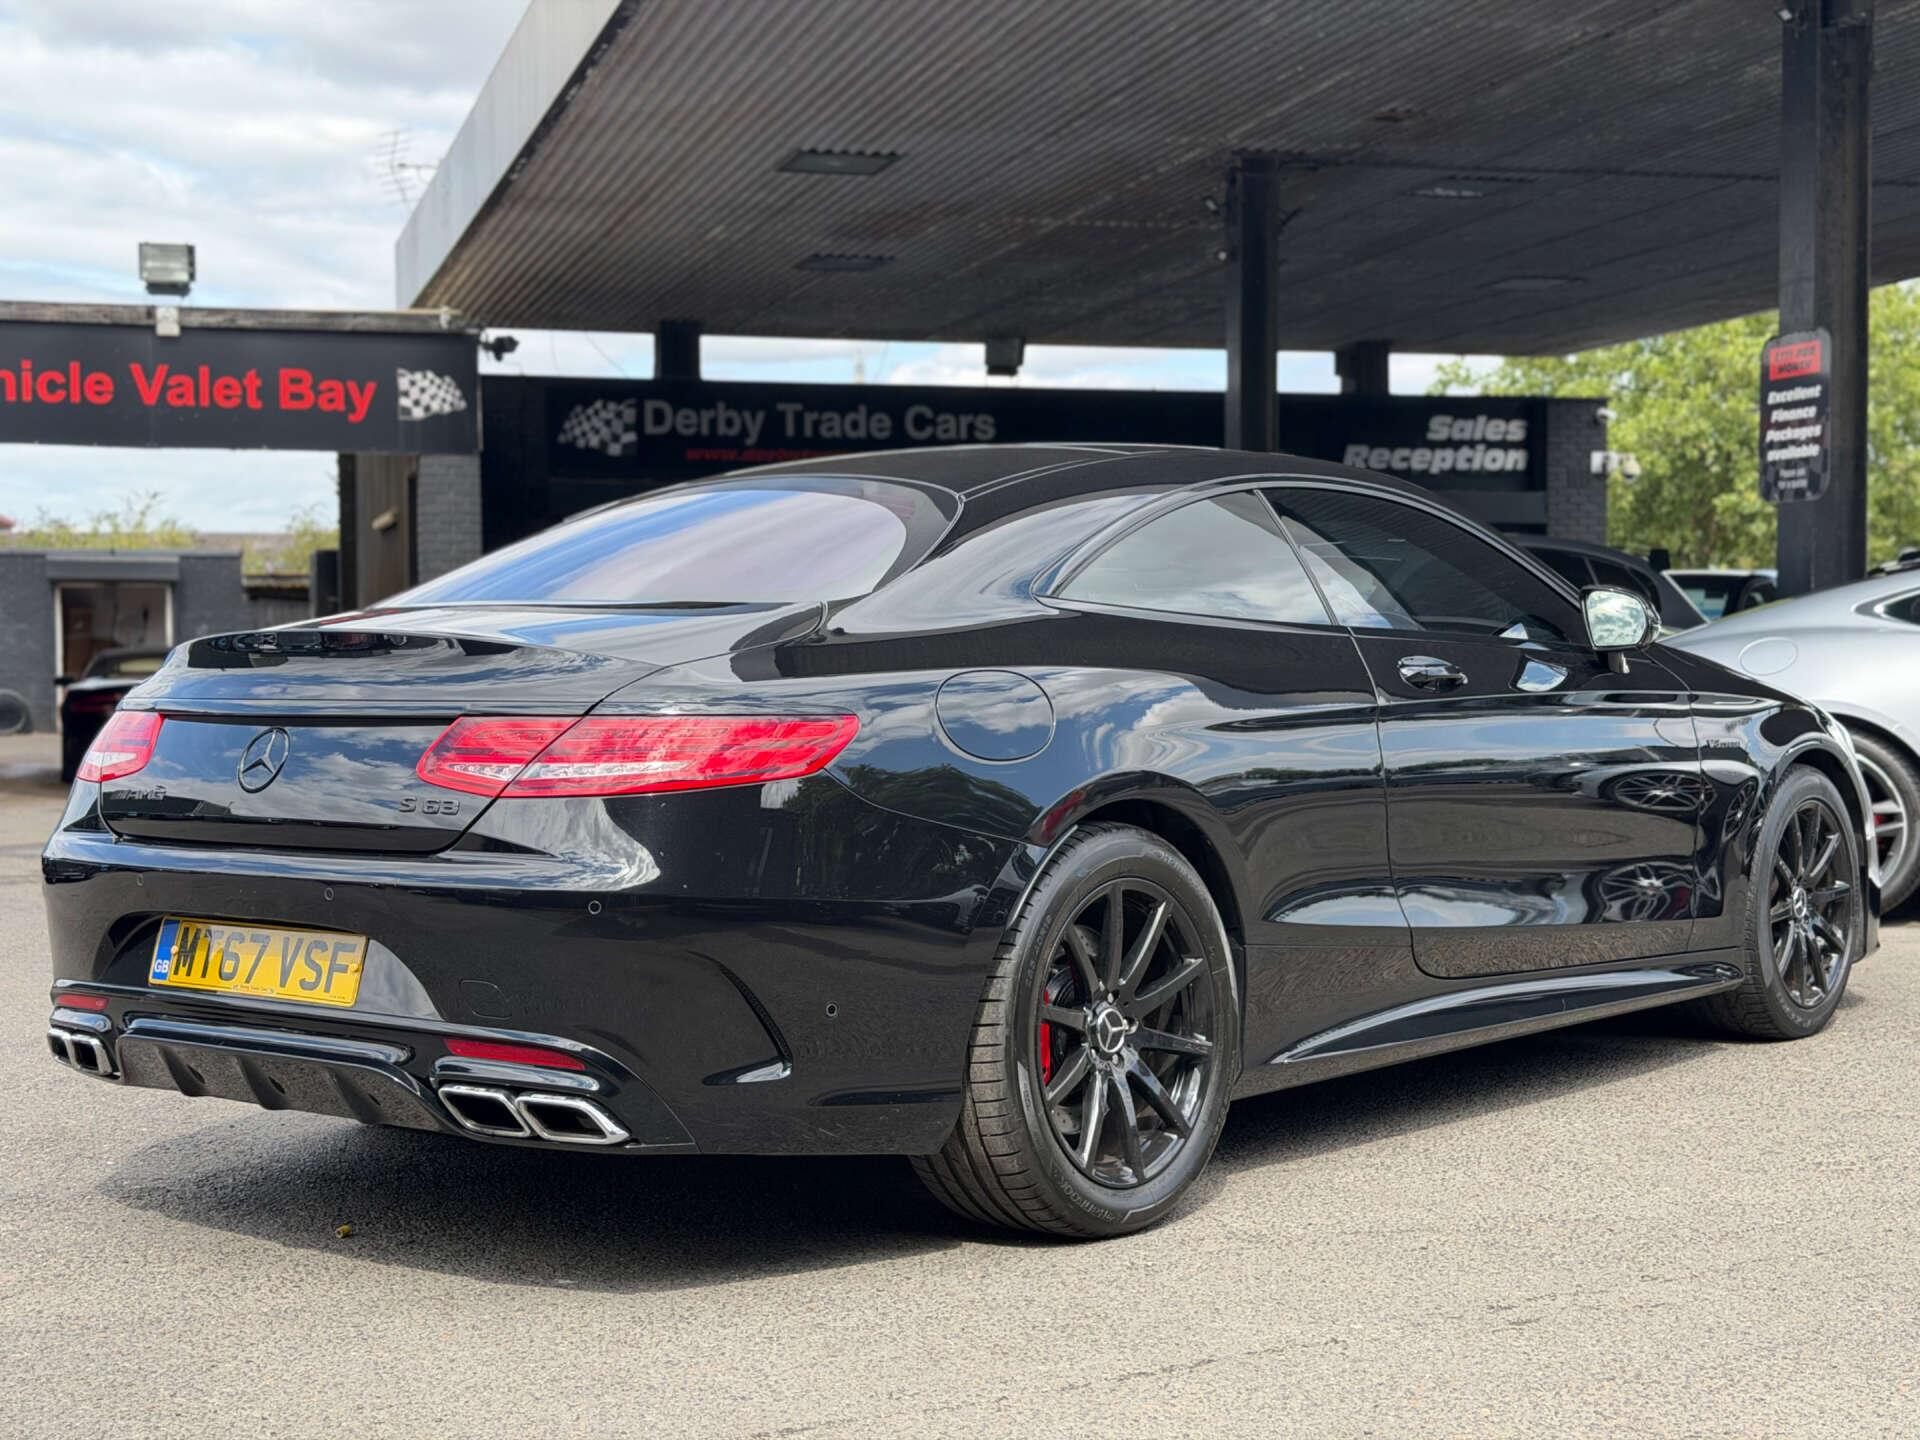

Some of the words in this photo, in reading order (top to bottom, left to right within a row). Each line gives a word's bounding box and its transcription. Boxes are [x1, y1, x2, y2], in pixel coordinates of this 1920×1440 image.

[130, 363, 263, 410] Valet
[279, 367, 377, 422] Bay
[643, 400, 766, 445] Derby
[776, 403, 892, 440] Trade
[904, 405, 997, 441] Cars
[1426, 415, 1527, 442] Sales
[1343, 444, 1527, 474] Reception
[399, 797, 417, 812] S
[422, 799, 460, 816] 63
[155, 959, 169, 973] GB
[173, 927, 272, 984] MT67
[279, 937, 357, 993] VSF
